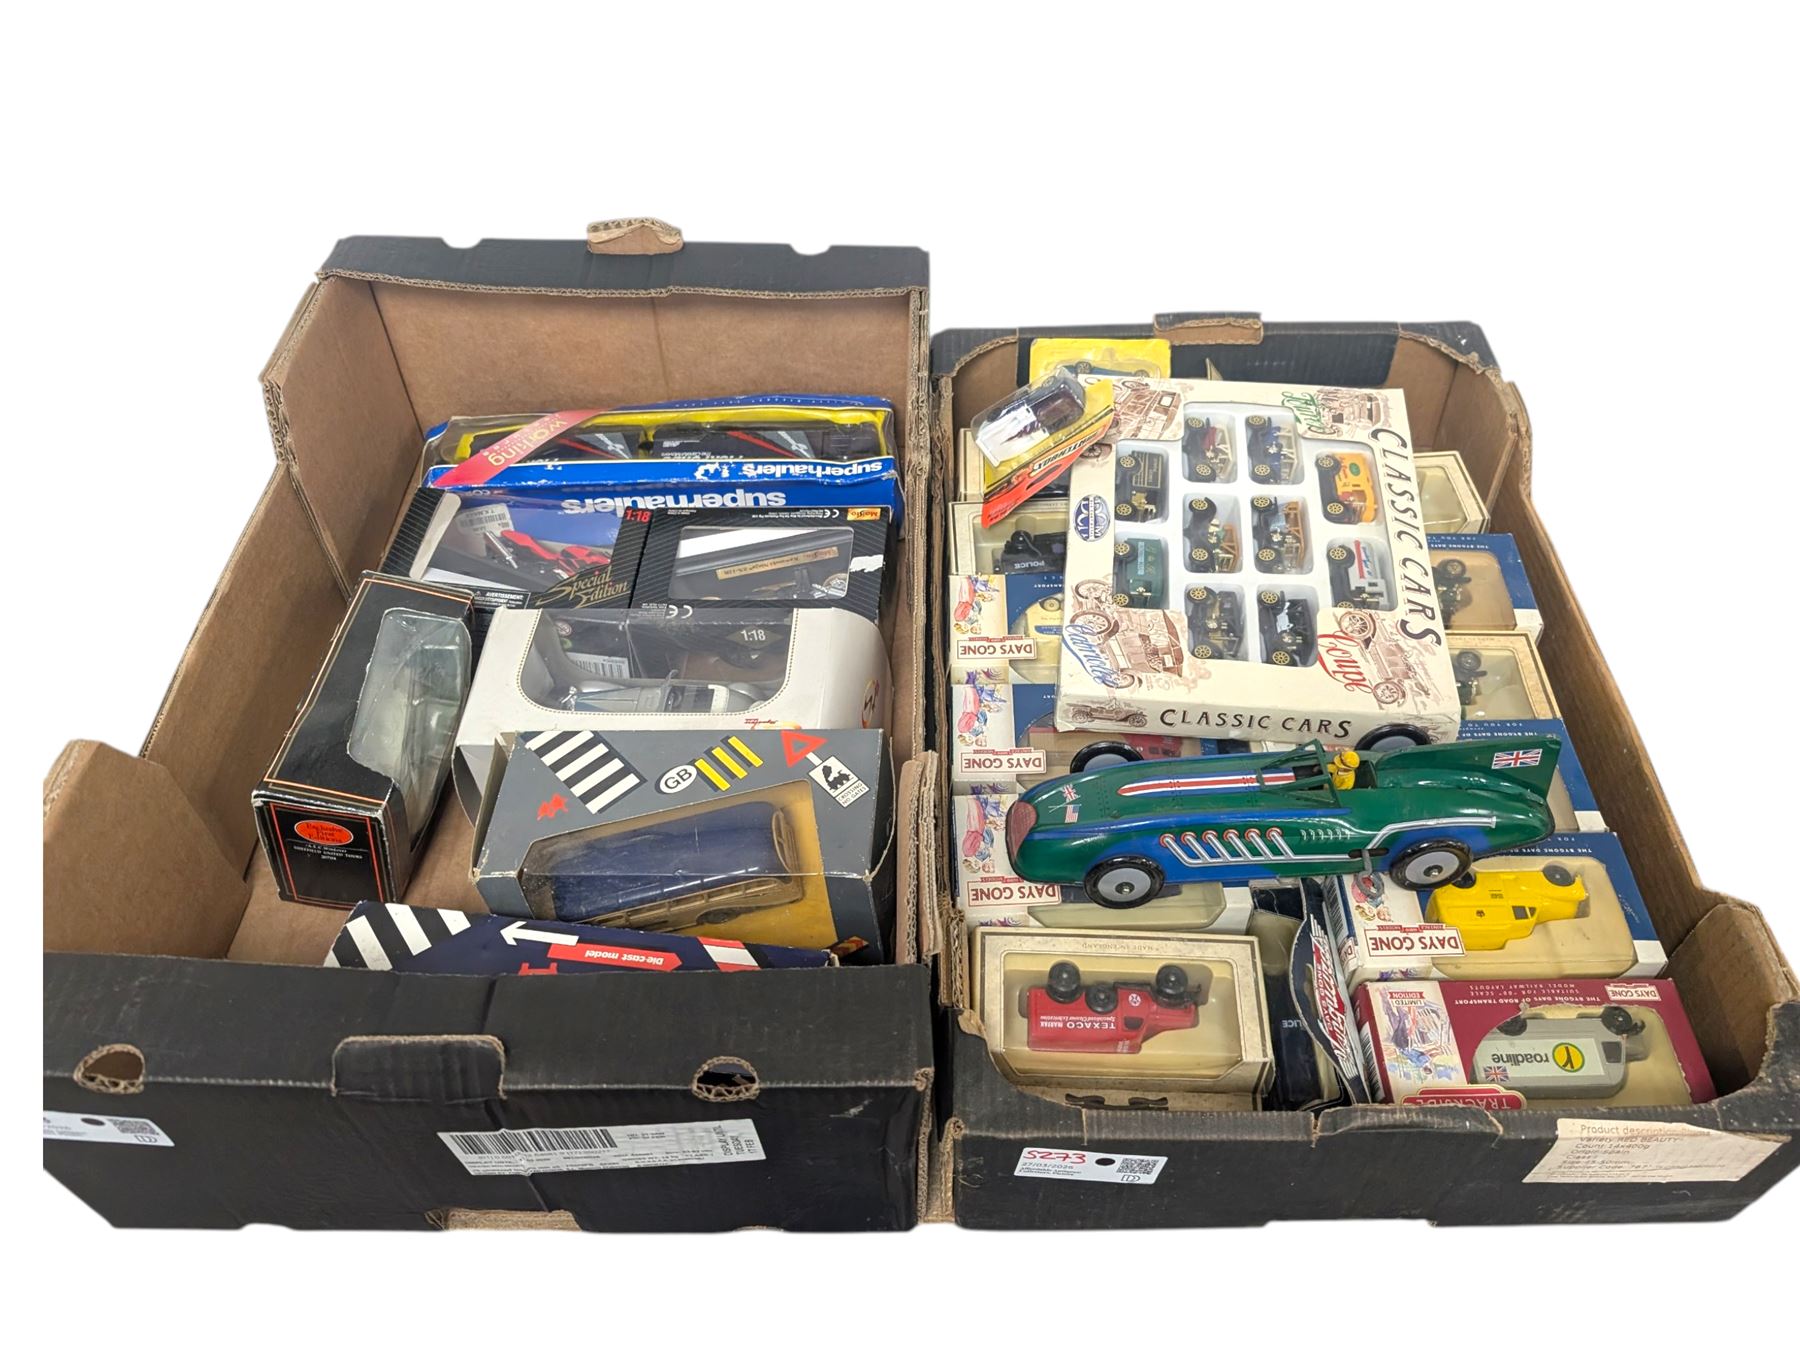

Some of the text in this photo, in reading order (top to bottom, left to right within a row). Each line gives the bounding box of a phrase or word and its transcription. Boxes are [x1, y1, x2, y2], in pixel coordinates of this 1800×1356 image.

[488, 418, 568, 468] working
[743, 461, 883, 478] superhaulers
[624, 508, 651, 523] 1:18
[850, 511, 879, 519] Maisto
[1371, 428, 1442, 647] CLASSIC CARS
[1014, 560, 1045, 570] POLICE
[537, 565, 614, 606] Special
[571, 580, 631, 608] Edition
[741, 629, 766, 641] 1:18
[960, 643, 1033, 656] DAYS GONE
[1160, 708, 1352, 739] CLASSIC CARS
[963, 757, 1042, 769] DAYS GONE
[664, 768, 693, 790] GB
[838, 783, 863, 801] CROSSING
[842, 786, 868, 805] NO GATES
[970, 885, 1056, 901] DAYS GONE
[1081, 942, 1119, 950] ENGLAND
[1369, 936, 1460, 951] DAYS GONE
[584, 950, 664, 968] Die-cast model
[1392, 991, 1421, 999] EDITION
[1610, 990, 1657, 998] DAYS GONE
[1066, 1021, 1116, 1030] TEXACO
[1492, 1052, 1550, 1067] roadline
[1580, 1124, 1619, 1135] Product
